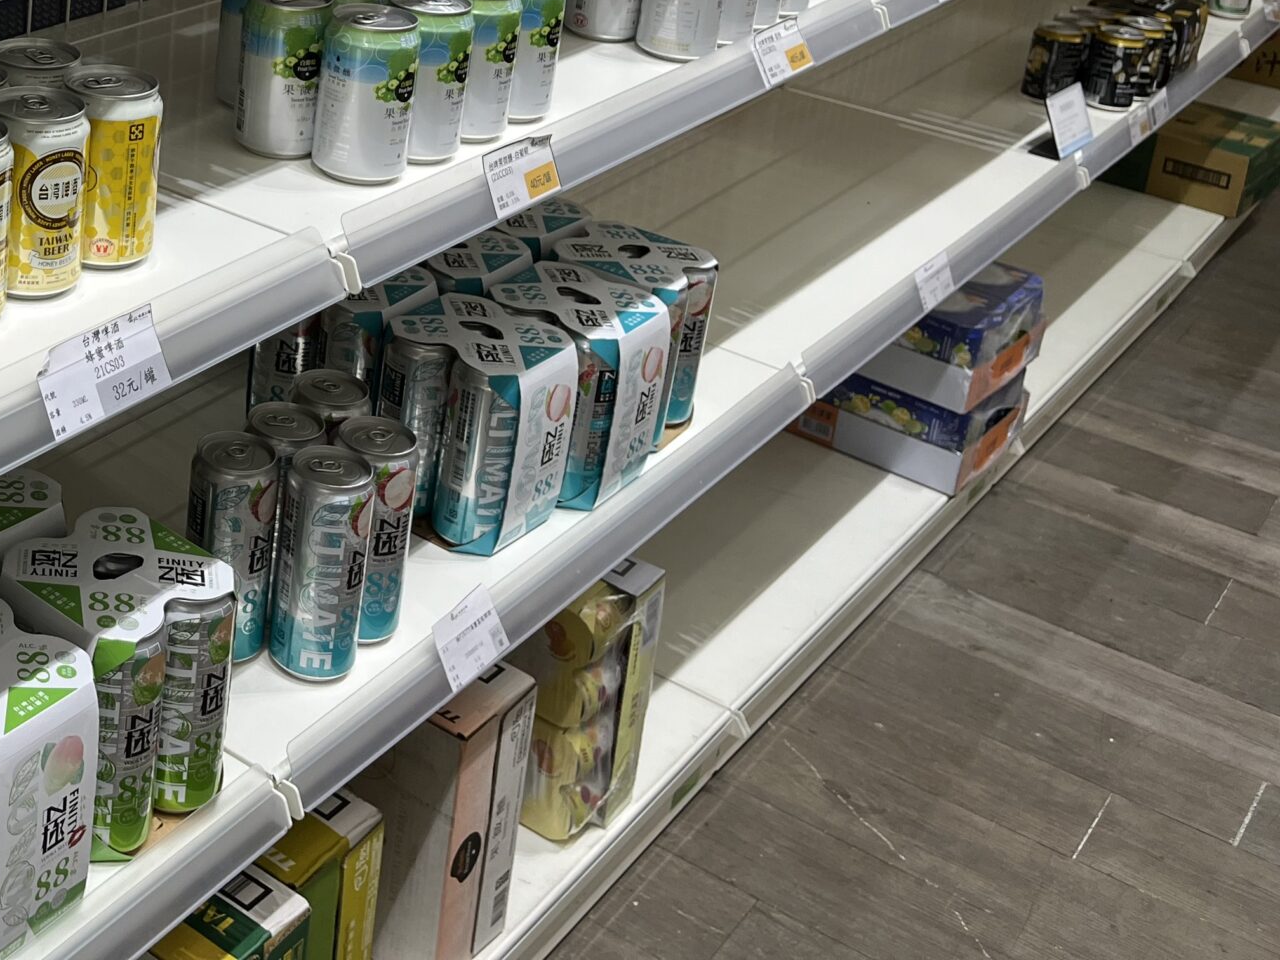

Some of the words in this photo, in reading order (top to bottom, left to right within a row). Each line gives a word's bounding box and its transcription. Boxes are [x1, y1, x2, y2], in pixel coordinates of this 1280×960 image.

[39, 233, 73, 247] TAIWAN
[43, 244, 70, 257] BEER
[82, 321, 120, 348] 台灣啤酒
[85, 337, 124, 364] 蜂蜜啤酒
[94, 355, 126, 379] 21CS03
[112, 367, 157, 401] 32元/罐
[646, 383, 657, 418] FINITY
[553, 422, 565, 458] FINITY
[30, 568, 77, 578] FINITY
[158, 558, 205, 567] FINITY
[70, 788, 79, 834] FINITY
